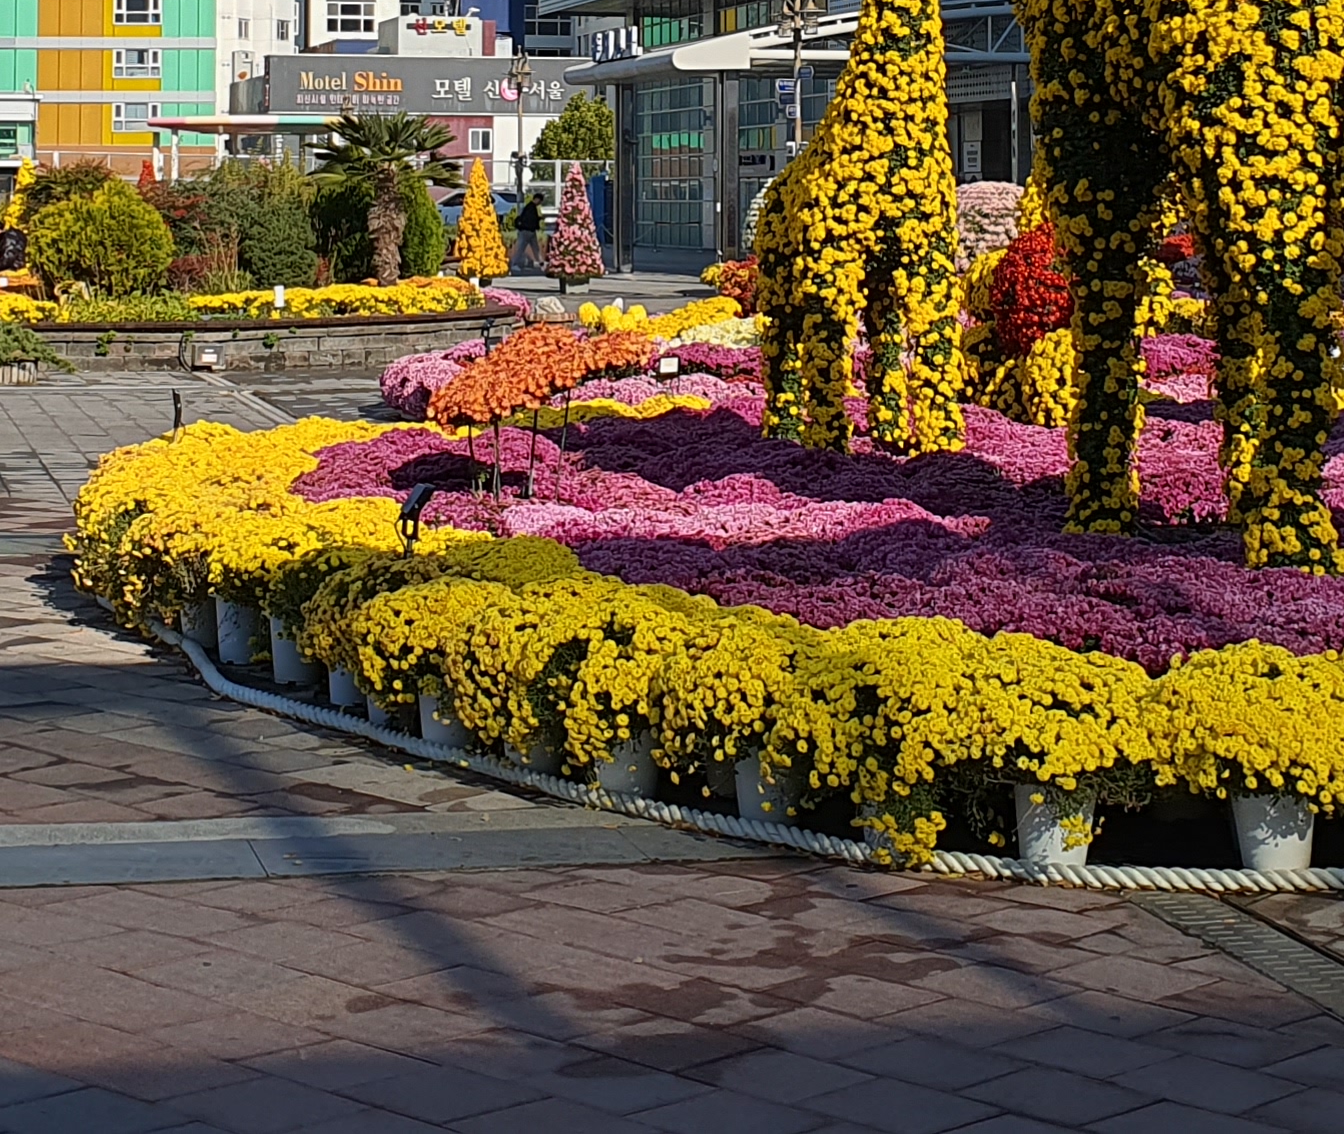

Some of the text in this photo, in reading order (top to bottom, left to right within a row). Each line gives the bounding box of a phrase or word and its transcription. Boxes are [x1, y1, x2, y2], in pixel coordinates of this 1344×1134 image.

[299, 71, 403, 92] Motel Shin
[431, 77, 472, 101] 모텔
